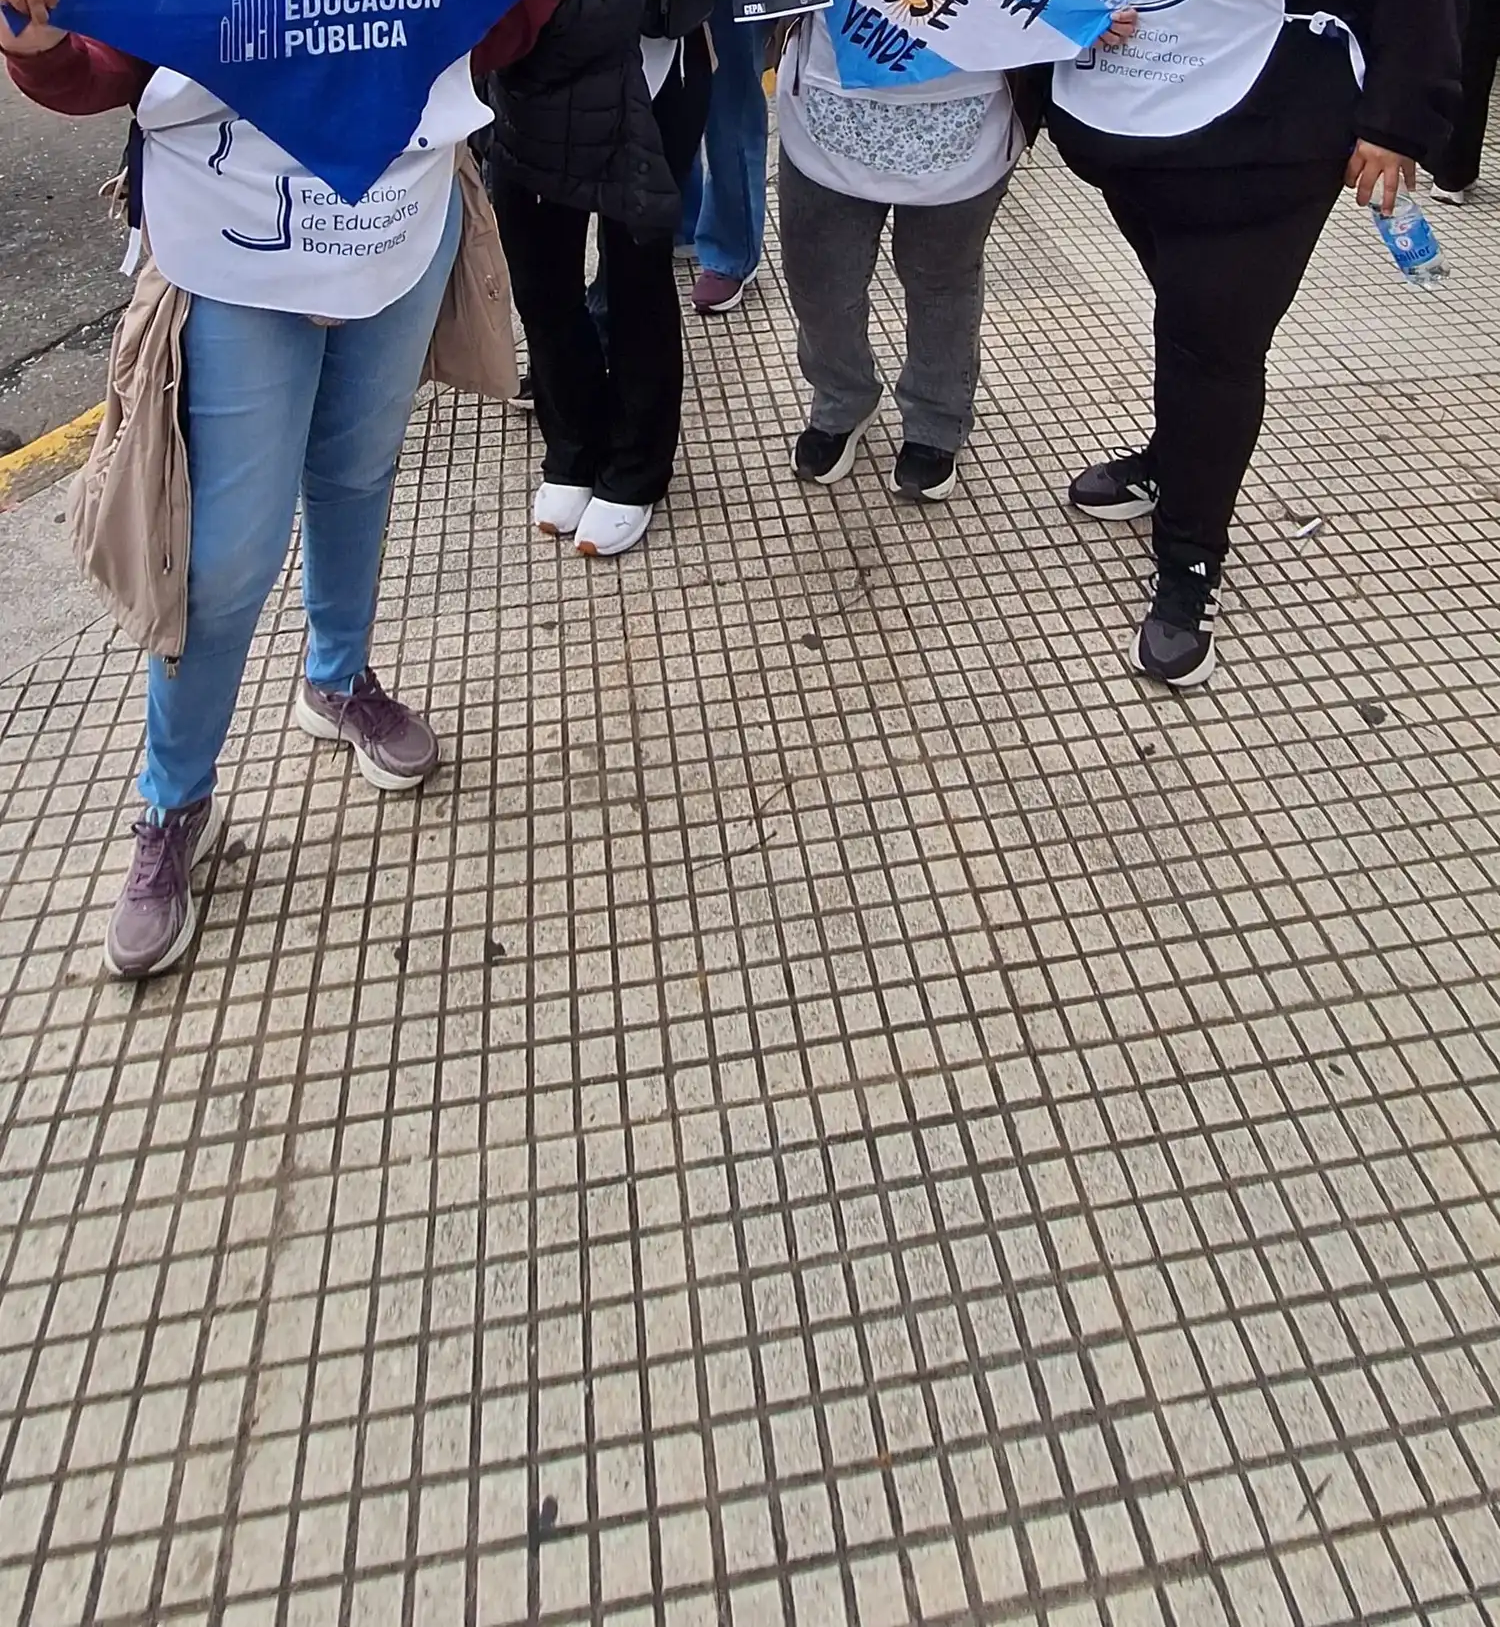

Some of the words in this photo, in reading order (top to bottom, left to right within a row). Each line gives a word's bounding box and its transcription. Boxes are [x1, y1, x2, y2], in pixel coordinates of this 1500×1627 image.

[285, 19, 407, 58] PÚBLICA
[1121, 43, 1206, 67] Educadores
[1099, 59, 1186, 84] Bonaerenses
[301, 214, 327, 231] de
[301, 229, 407, 257] Bonaerenses
